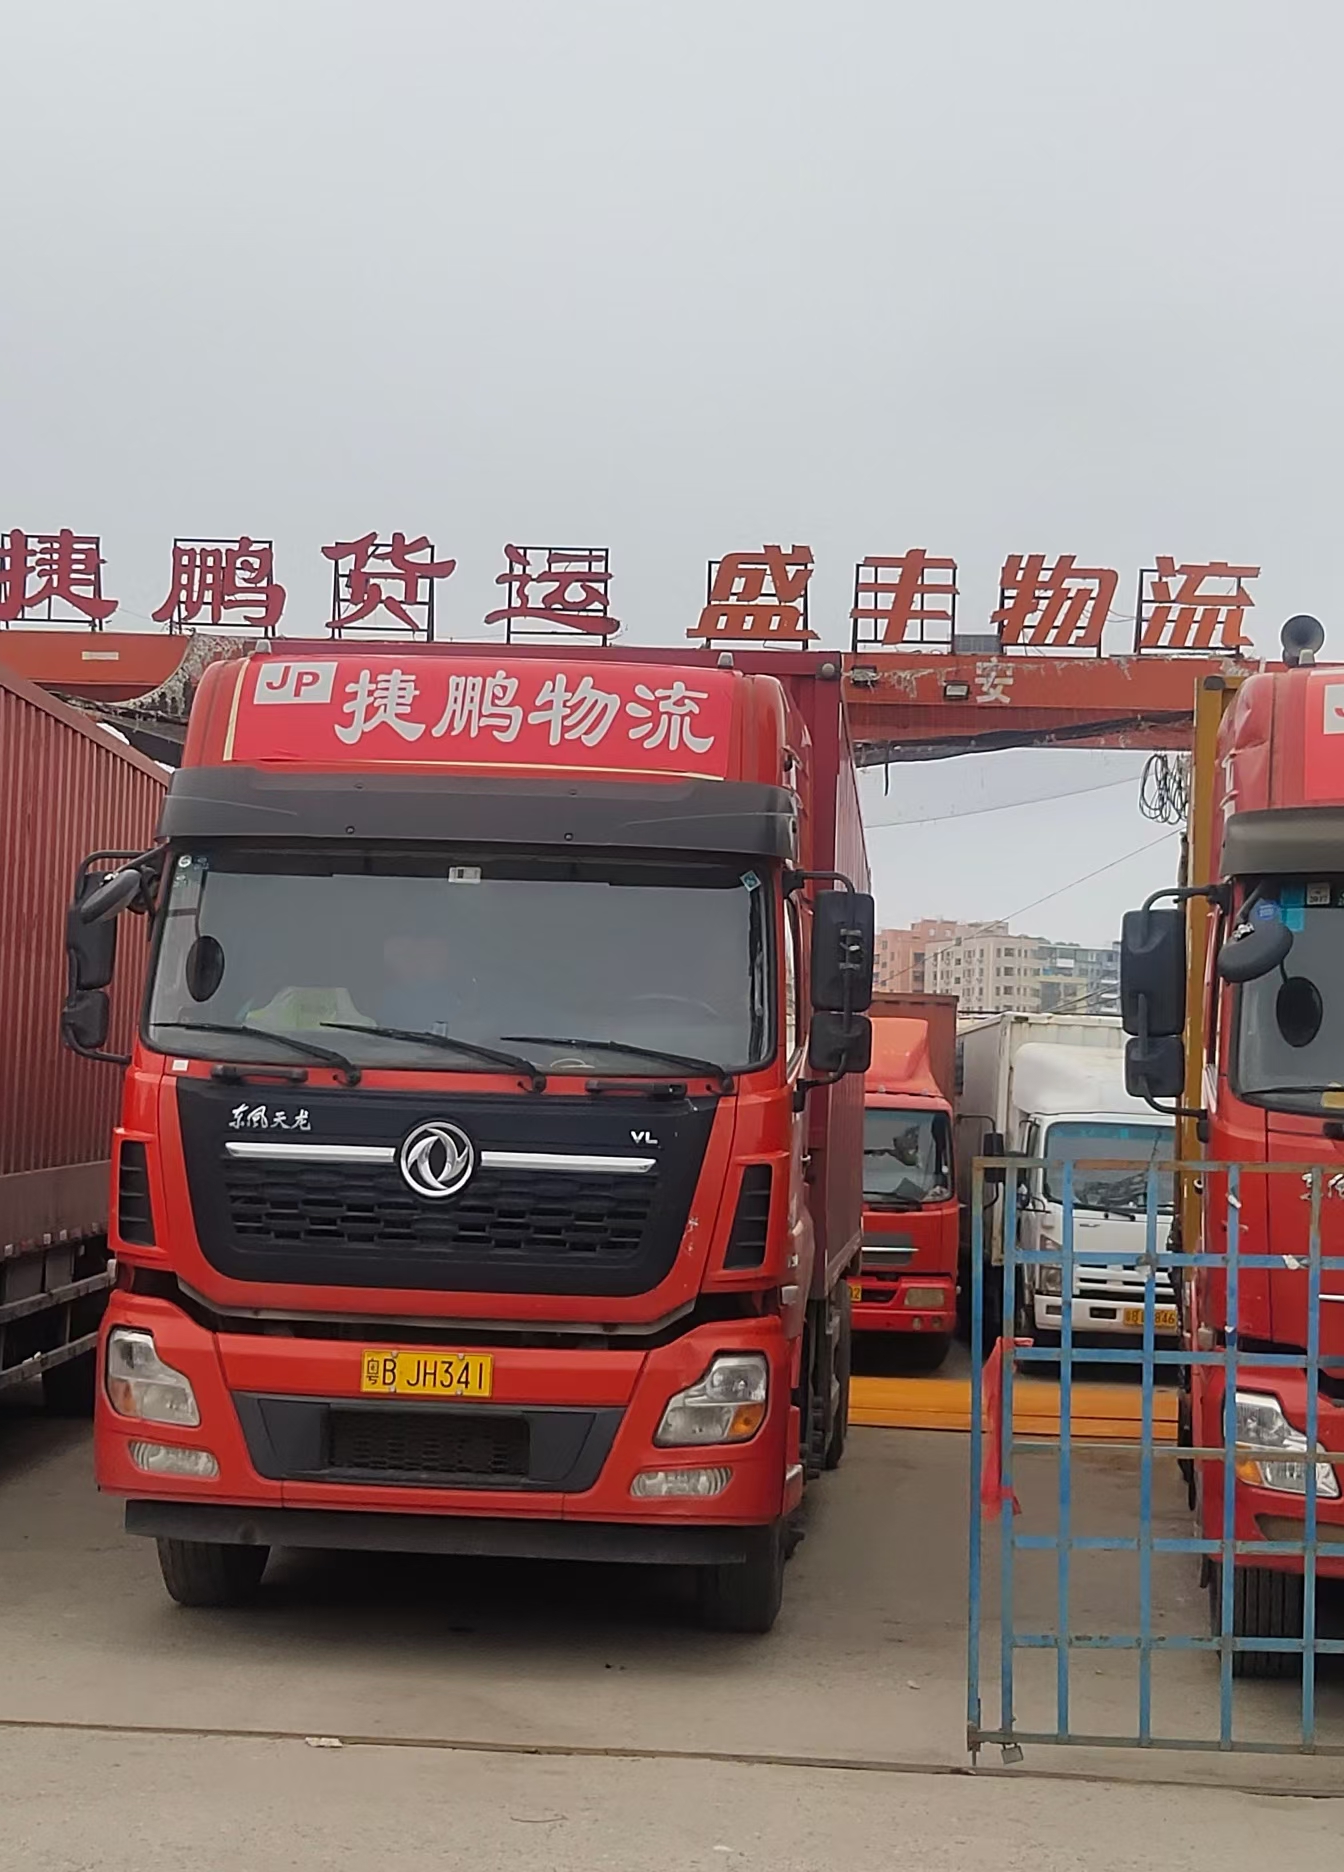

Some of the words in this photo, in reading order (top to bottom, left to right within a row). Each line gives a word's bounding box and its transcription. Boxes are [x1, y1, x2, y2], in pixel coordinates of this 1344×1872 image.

[686, 544, 1261, 647] 盛丰物流
[265, 665, 320, 699] JP
[334, 669, 716, 753] 捷鹏物流
[630, 1131, 658, 1144] VL
